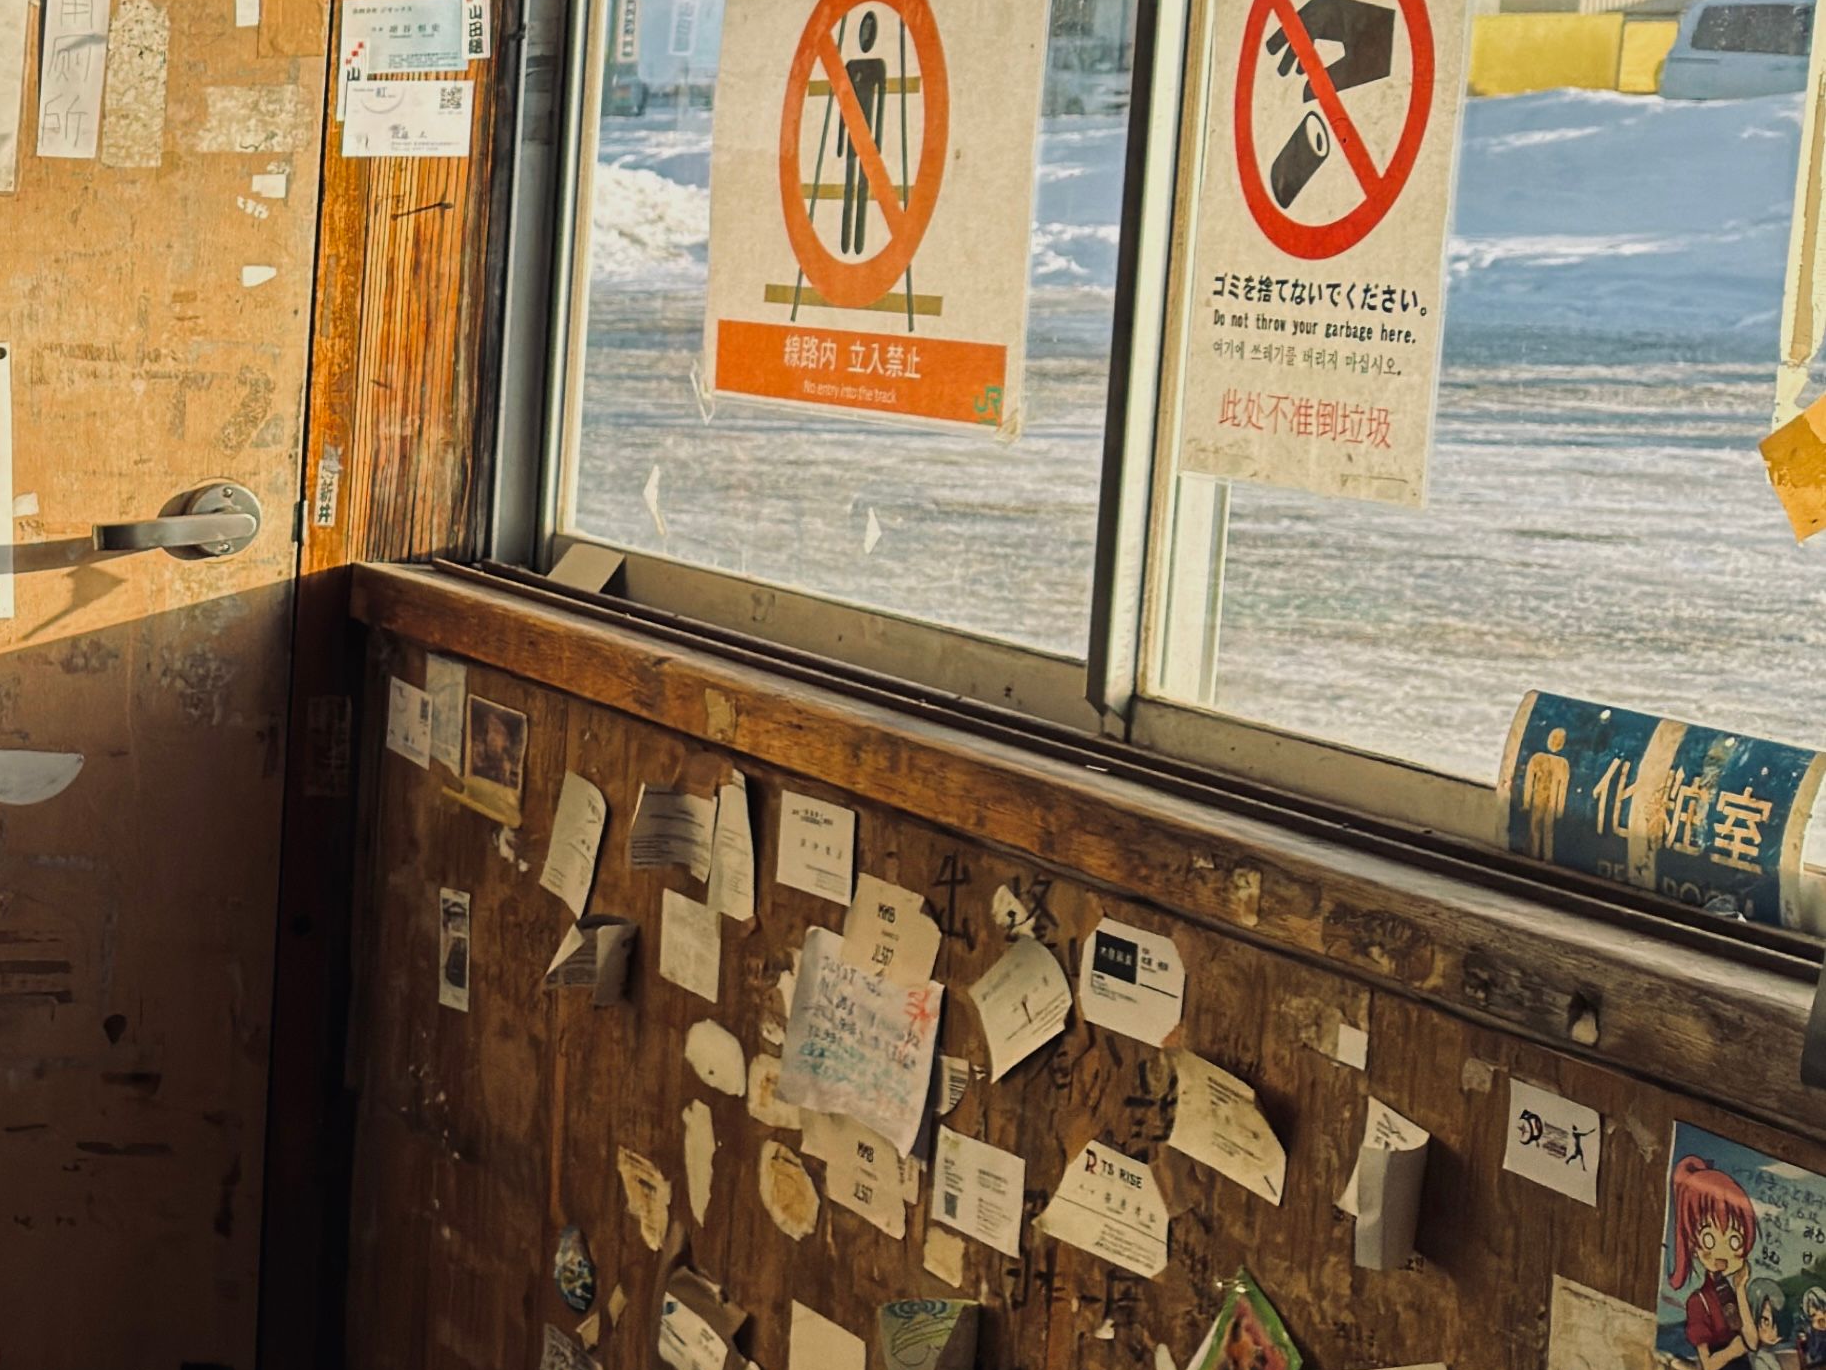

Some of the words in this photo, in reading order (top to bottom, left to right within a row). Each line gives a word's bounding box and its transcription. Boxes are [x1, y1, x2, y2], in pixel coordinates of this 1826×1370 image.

[1212, 272, 1427, 317] ゴミを捨てないでください。
[1213, 308, 1226, 327] Do
[1231, 311, 1249, 329] not
[1255, 312, 1286, 332] throw
[1291, 318, 1317, 336] your
[1324, 321, 1373, 342] garbage
[1380, 324, 1417, 344] here.
[782, 334, 837, 372] 線路内
[849, 340, 922, 380] 立入禁止
[1213, 339, 1245, 359] 여기에
[1250, 343, 1296, 367] 쓰레기를
[1302, 349, 1339, 372] 버리지
[1345, 355, 1402, 377] 마십시오.
[972, 385, 1003, 415] JR
[1218, 387, 1391, 450] 此处不准倒垃圾
[1592, 757, 1773, 875] 化粧室
[1118, 1167, 1144, 1189] RISE
